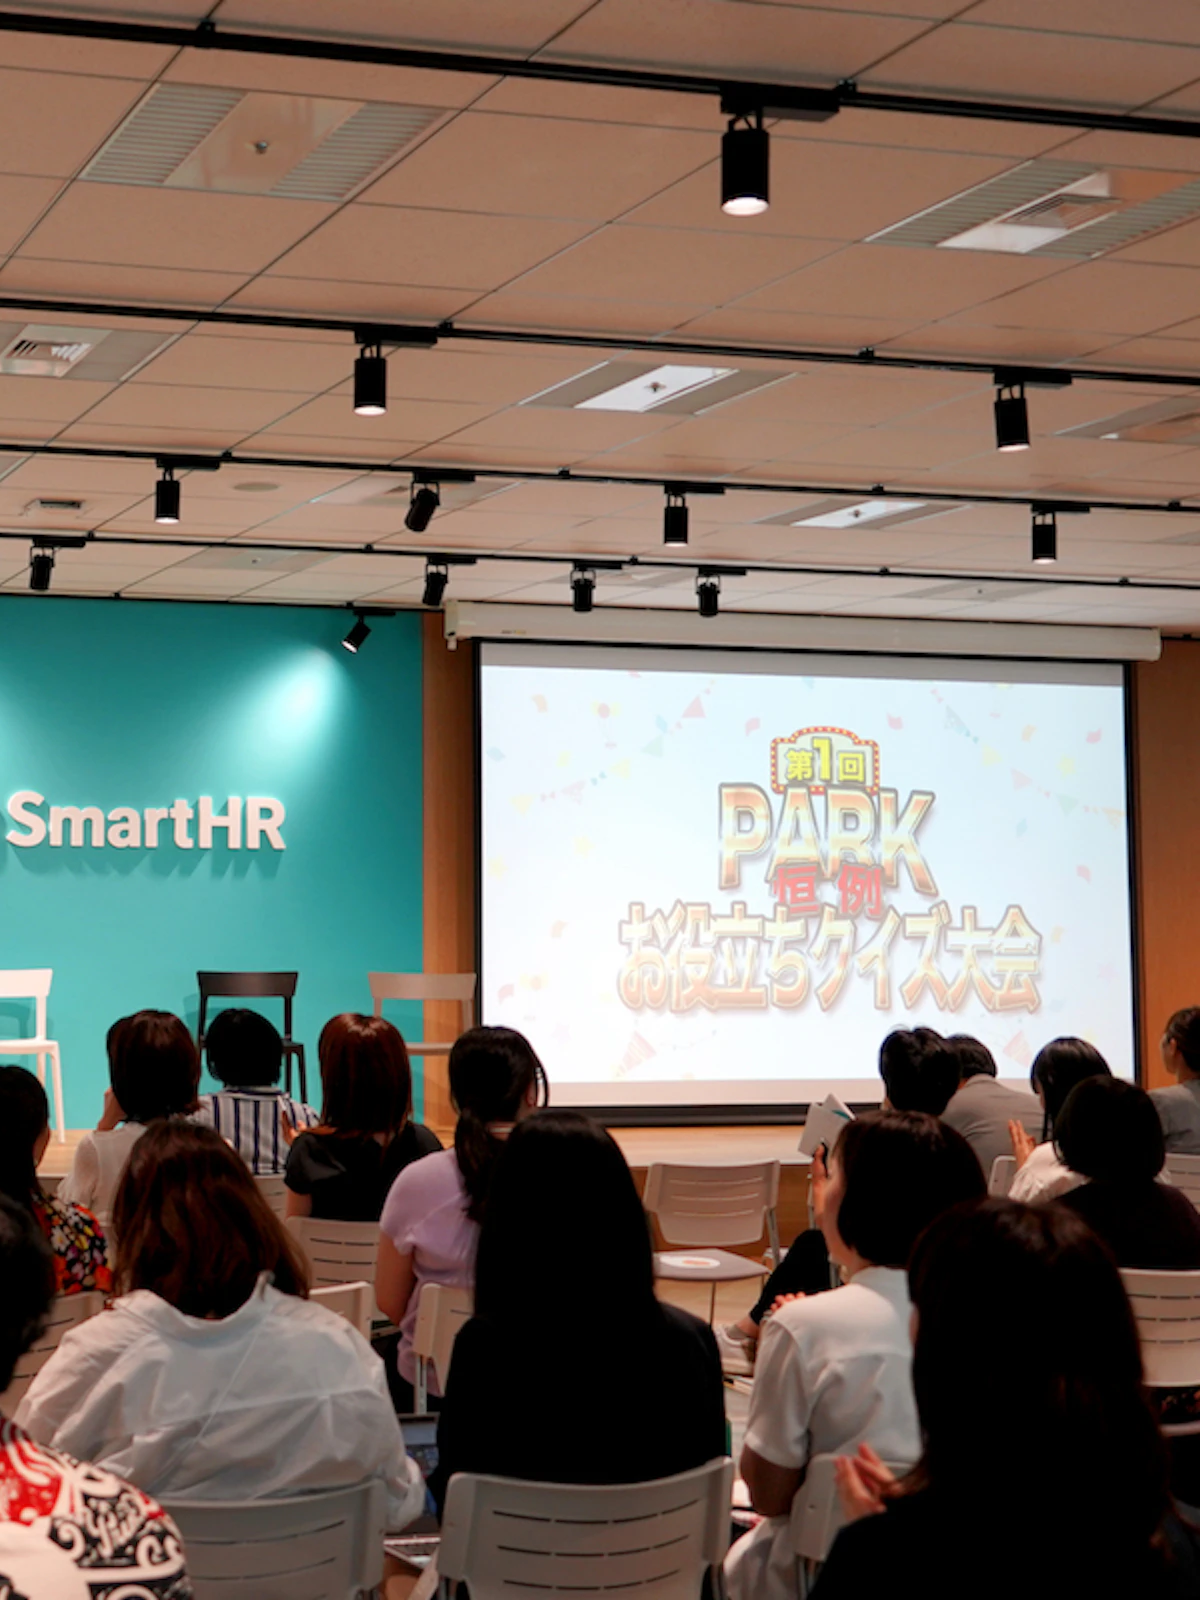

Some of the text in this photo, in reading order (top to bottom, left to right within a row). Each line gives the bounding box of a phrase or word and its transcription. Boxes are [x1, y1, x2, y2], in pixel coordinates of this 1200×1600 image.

[785, 737, 866, 783] 第1回
[5, 790, 287, 850] SmartHR
[718, 782, 938, 896] PARK
[618, 900, 1042, 1013] お役立ちクイズ大会
